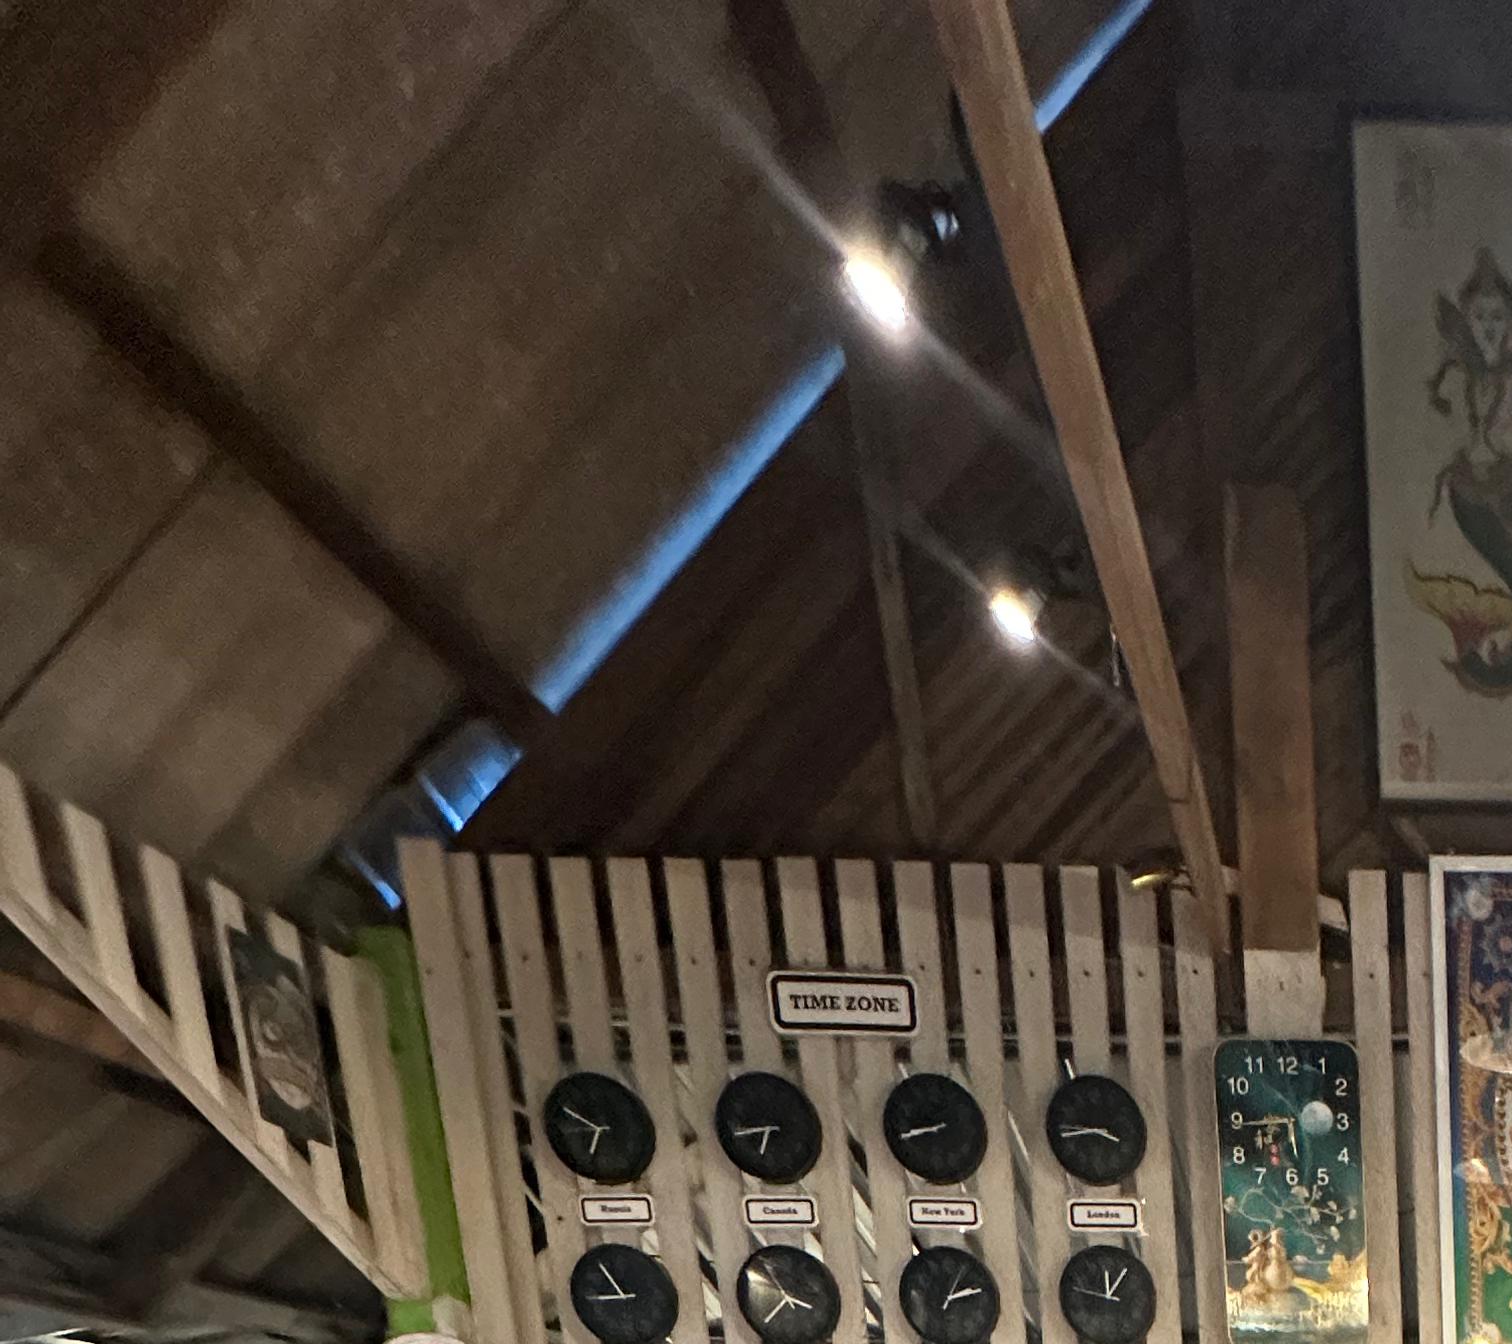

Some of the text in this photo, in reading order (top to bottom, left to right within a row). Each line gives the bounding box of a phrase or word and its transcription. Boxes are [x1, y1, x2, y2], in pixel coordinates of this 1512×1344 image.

[790, 994, 899, 1012] TIME ZONE
[1245, 1056, 1264, 1074] 11
[1277, 1057, 1298, 1074] 12
[1318, 1058, 1327, 1074] 1
[1228, 1077, 1248, 1095] 10
[1335, 1079, 1347, 1096] 2
[1231, 1113, 1243, 1130] 9
[1337, 1114, 1349, 1131] 3
[1233, 1147, 1245, 1165] 8
[1337, 1148, 1349, 1164] 4
[1254, 1169, 1266, 1185] 7
[1286, 1169, 1299, 1186] 6
[1317, 1169, 1329, 1186] 5
[921, 1207, 966, 1216] New York
[1087, 1210, 1120, 1219] London
